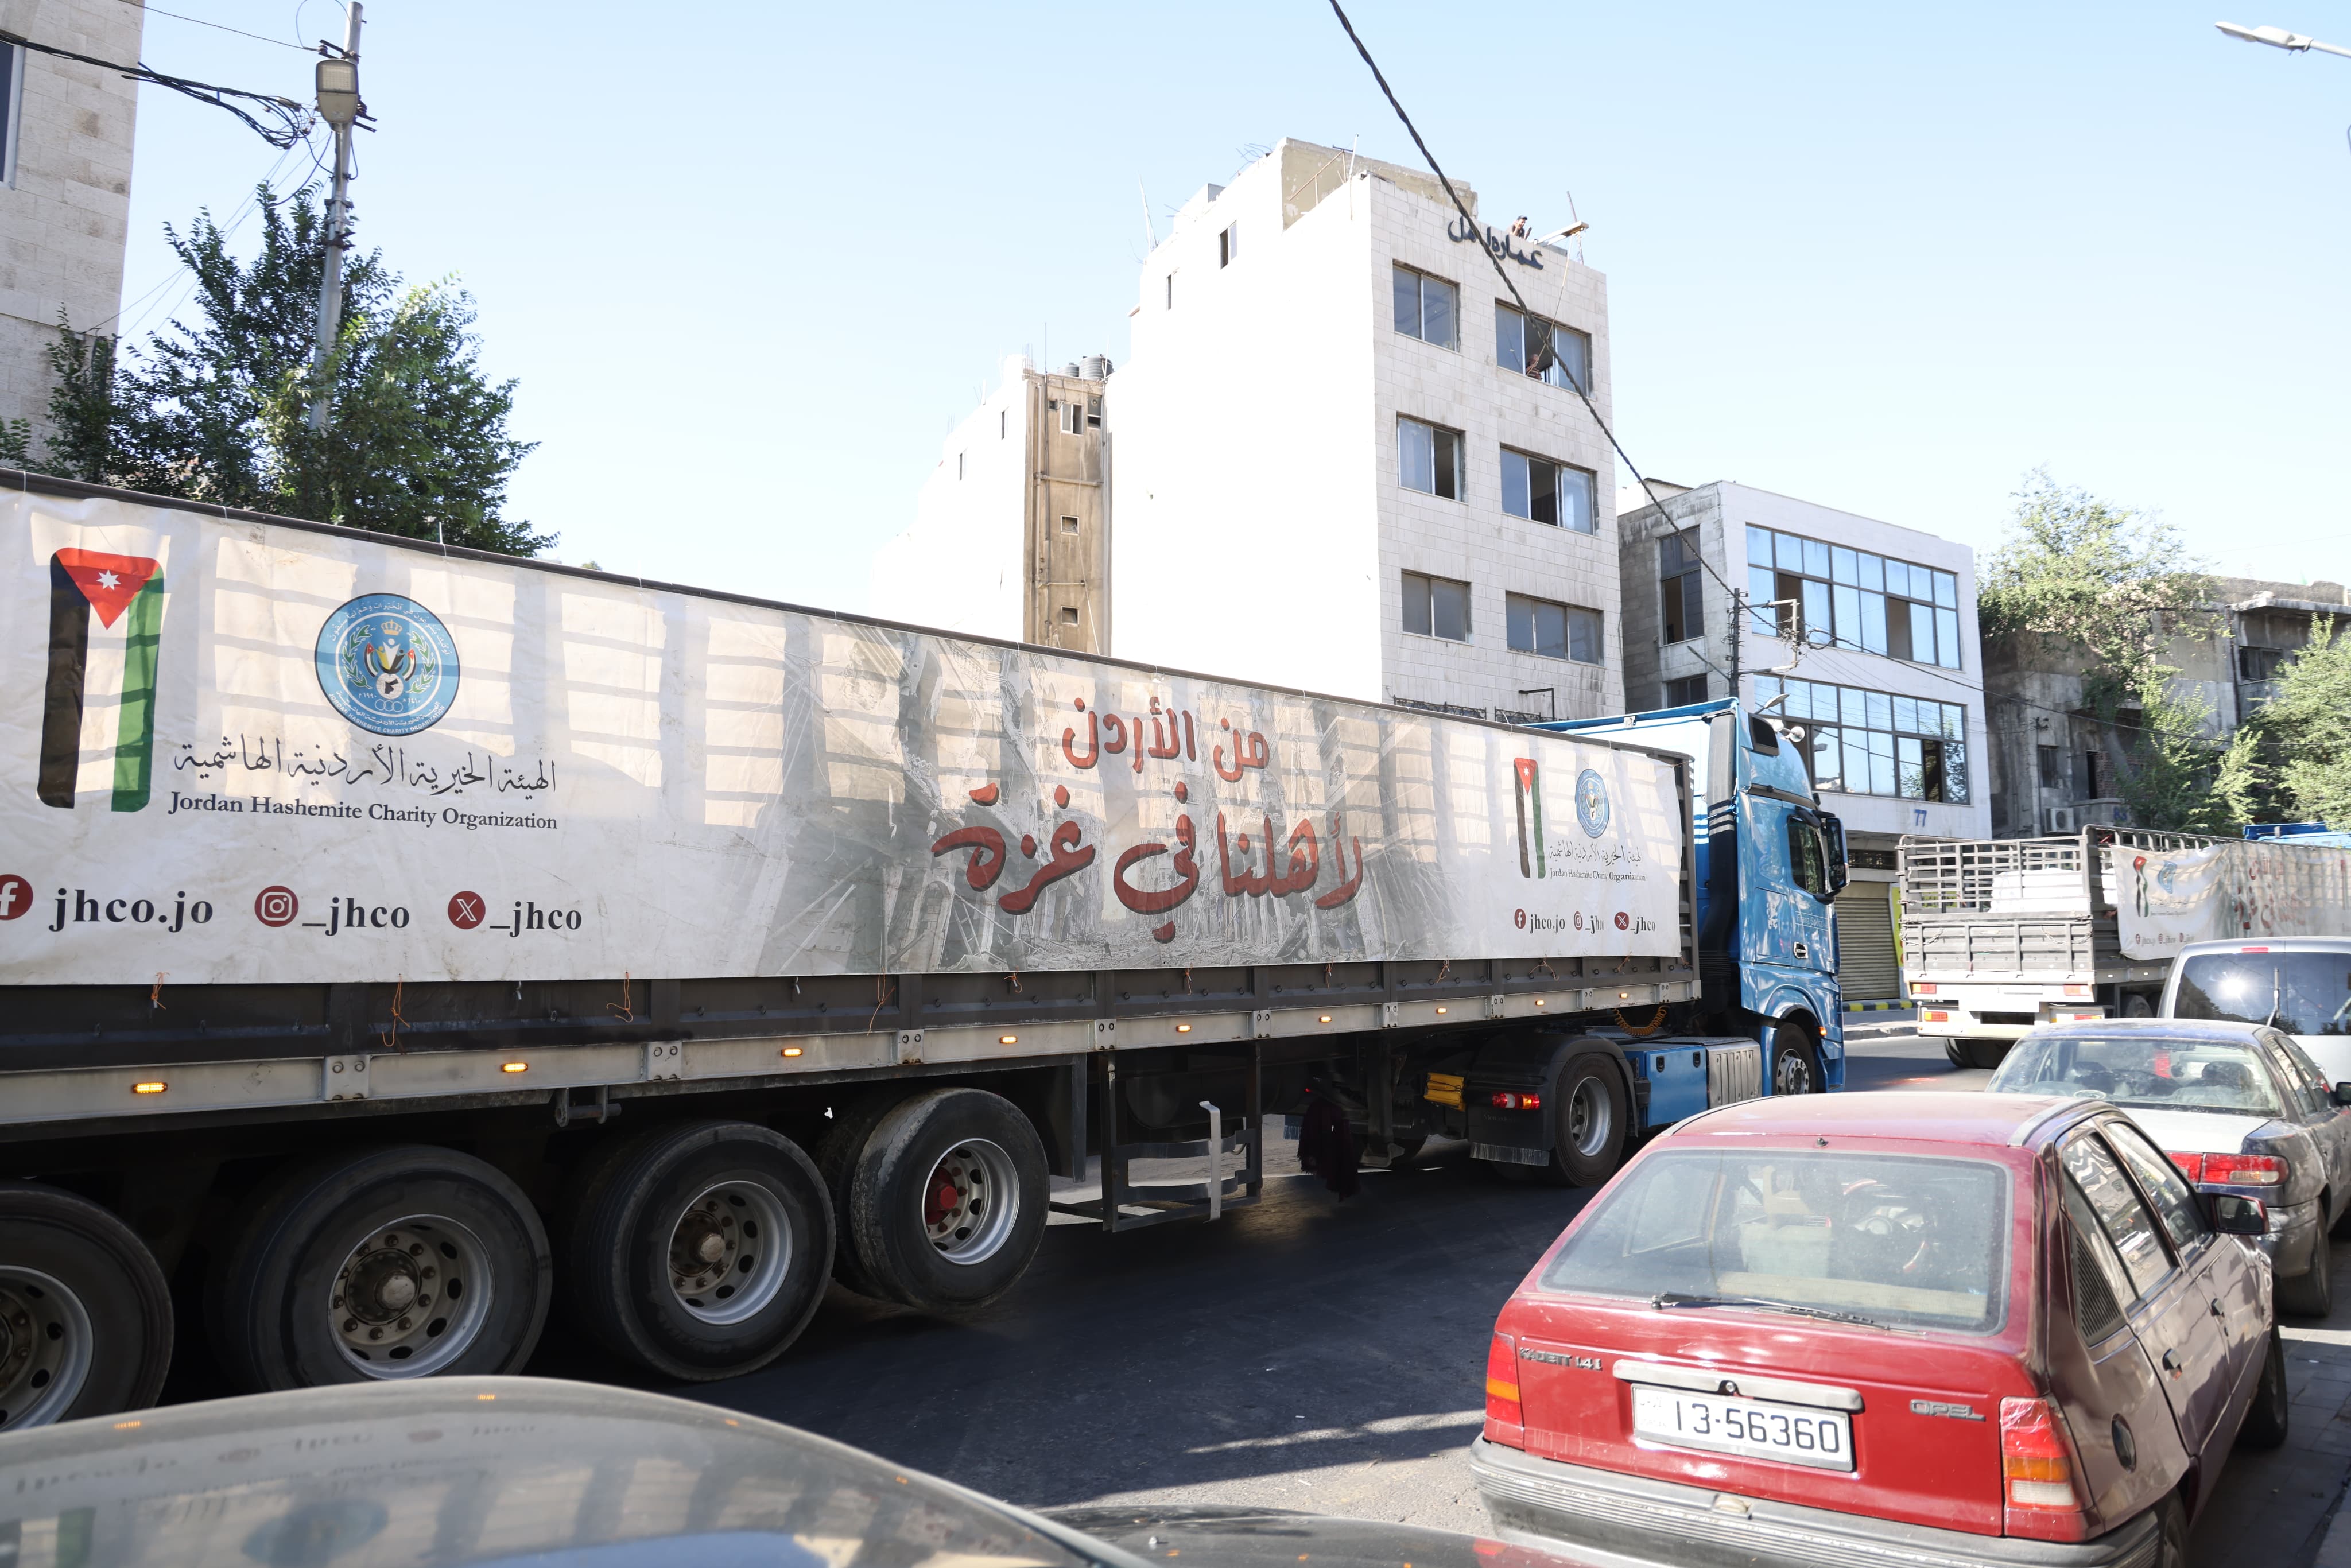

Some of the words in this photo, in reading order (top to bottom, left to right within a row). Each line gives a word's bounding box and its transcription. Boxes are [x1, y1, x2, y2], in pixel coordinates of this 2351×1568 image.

[328, 693, 348, 714] JORDAN
[348, 713, 382, 732] HASHEMITE
[409, 705, 446, 731] ORGANIZATION
[1062, 696, 1197, 773] الأردن
[174, 732, 281, 779] الهاشمية
[288, 743, 404, 786] الأردنية
[1214, 717, 1270, 783] من
[409, 751, 493, 797] الخيرية
[498, 758, 556, 801] الهيئة
[167, 790, 244, 815] Jordan
[250, 795, 363, 819] Hashemite
[368, 803, 437, 828] Charity
[442, 807, 558, 830] Organization
[1914, 809, 1927, 828] 77
[930, 781, 1097, 916] غزة
[1112, 780, 1200, 944] في
[1217, 809, 1364, 911] لأهلنا
[1549, 867, 1568, 879] Jordan
[48, 887, 214, 933] jhco.jo
[1529, 914, 1566, 934] jhco.jo
[1519, 1347, 1573, 1367] KADETT
[1676, 1400, 1840, 1453] 13-56360
[1910, 1399, 1987, 1422] OPEL
